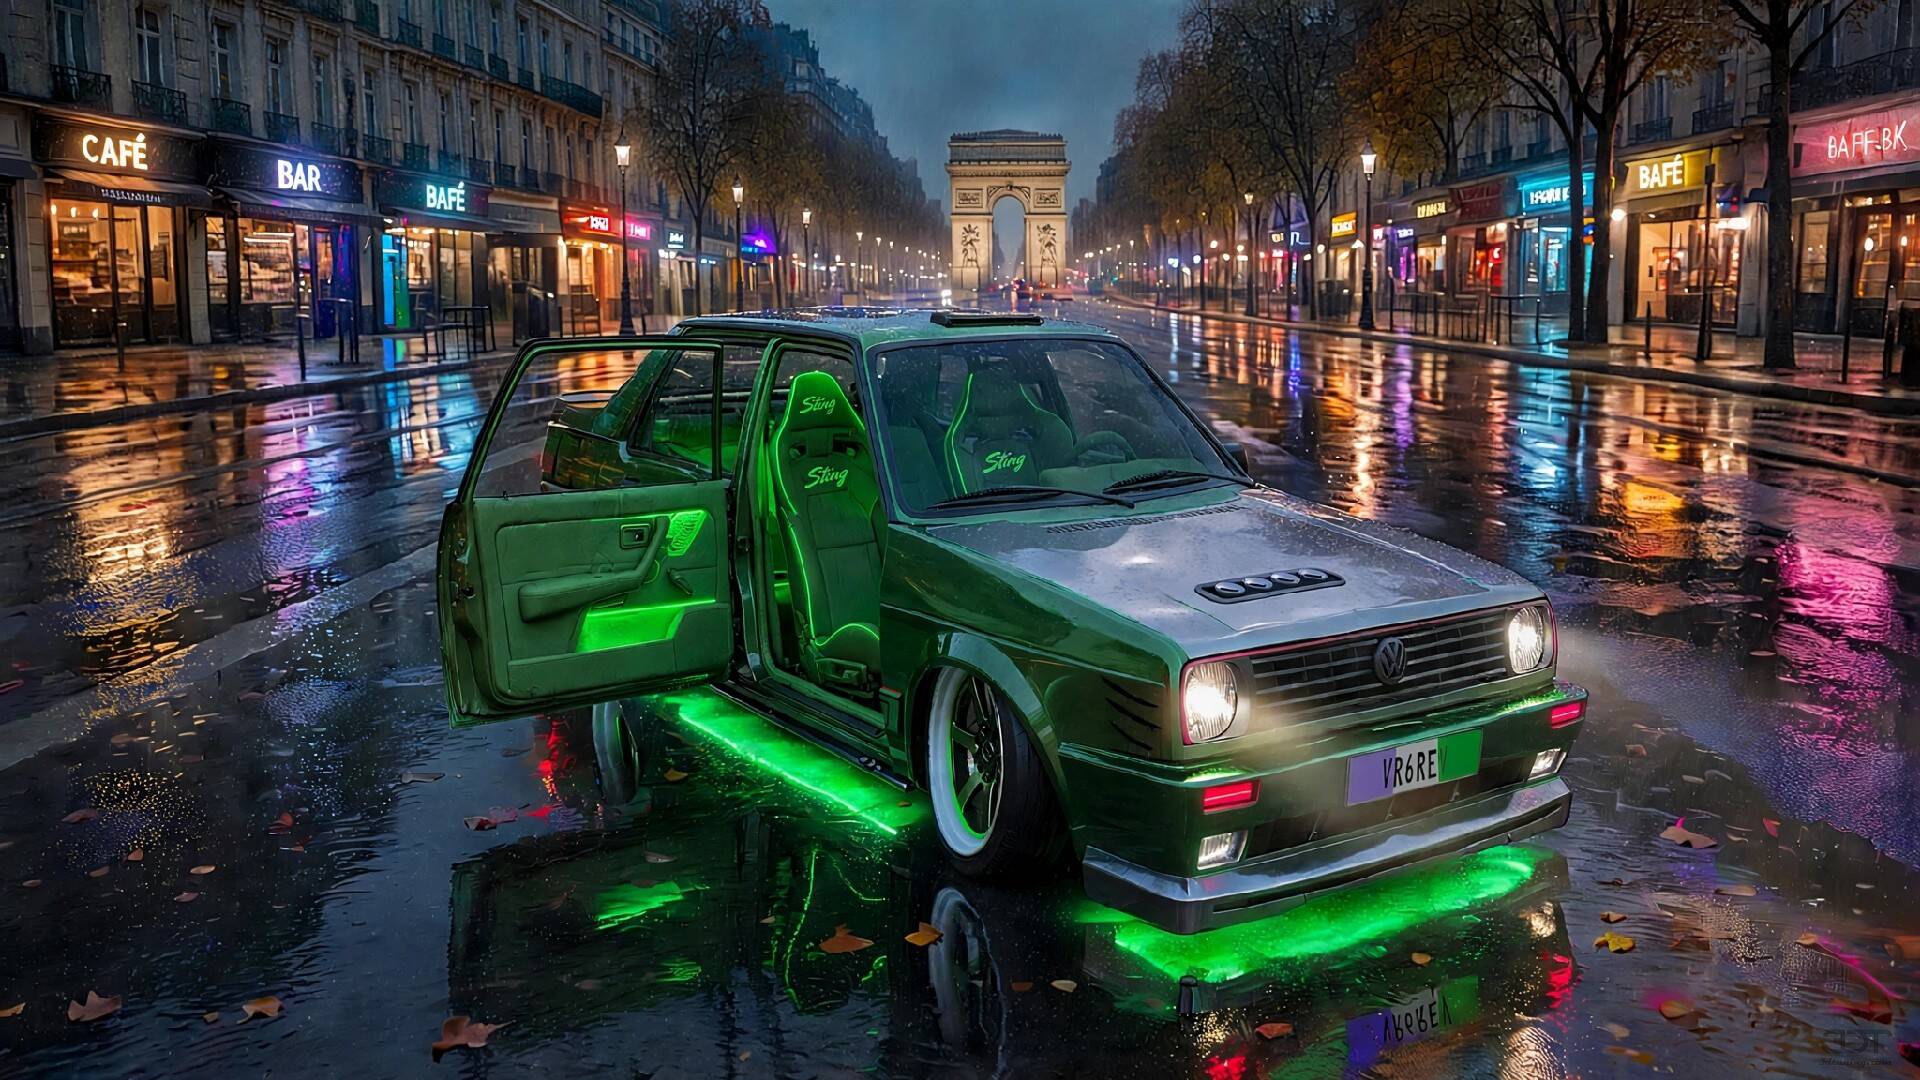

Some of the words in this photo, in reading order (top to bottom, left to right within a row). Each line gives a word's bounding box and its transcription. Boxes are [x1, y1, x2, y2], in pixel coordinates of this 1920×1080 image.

[82, 132, 148, 171] CAFÉ
[277, 159, 322, 192] BAR
[1639, 153, 1684, 189] BAFÉ
[426, 181, 466, 212] BAFÉ
[800, 396, 836, 415] Sting
[804, 466, 849, 489] Sting
[983, 450, 1026, 474] Sting
